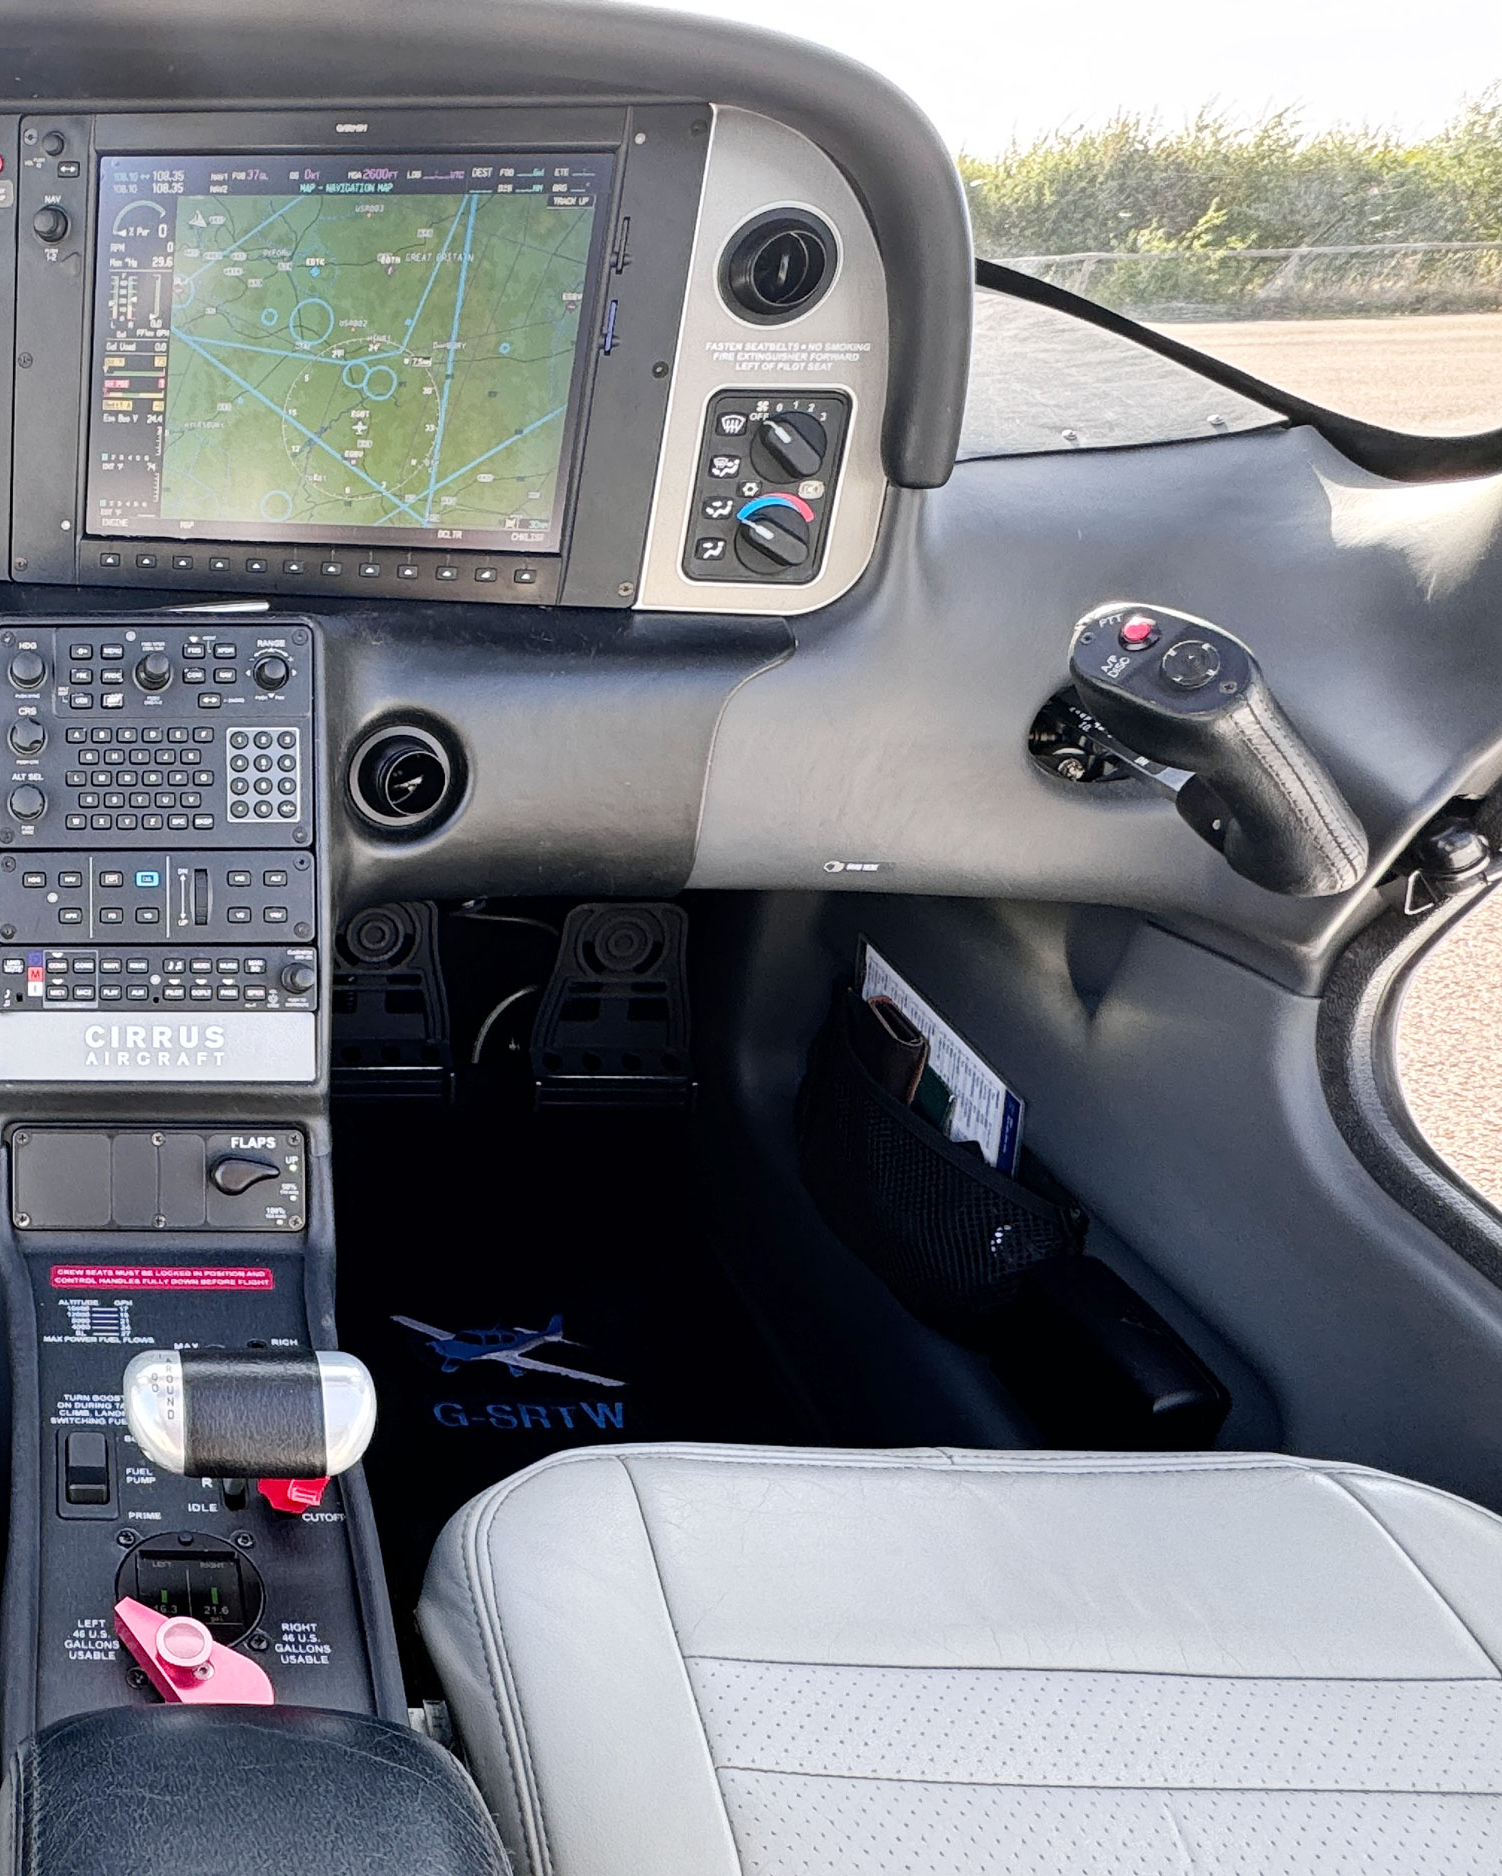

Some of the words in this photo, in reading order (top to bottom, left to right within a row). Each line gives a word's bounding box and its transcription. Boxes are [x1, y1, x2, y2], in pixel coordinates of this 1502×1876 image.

[325, 183, 375, 193] NAVIGATION
[45, 195, 62, 204] NAV
[705, 342, 743, 351] FASTEN
[744, 343, 799, 351] SEATBELTS
[808, 343, 823, 351] NO
[824, 343, 871, 351] SMOKING
[713, 352, 735, 361] FIRE
[737, 352, 808, 361] EXTINGUISHER
[809, 352, 860, 361] FORWARD
[735, 362, 759, 371] LEFT
[761, 362, 774, 371] OF
[776, 362, 805, 371] PILOT
[807, 362, 832, 371] SEAT
[749, 412, 770, 421] OFF
[776, 403, 783, 412] 0
[807, 403, 815, 412] 2
[820, 413, 827, 421] 3
[1099, 614, 1124, 629] PTT
[19, 642, 38, 650] HDG
[257, 640, 285, 648] RANGE
[18, 707, 37, 716] CRS
[12, 773, 26, 781] ALT
[28, 773, 43, 781] SEL
[85, 1025, 225, 1048] CIRRUS
[85, 1051, 225, 1066] AIRCRAFT
[231, 1137, 276, 1149] FLAPS
[285, 1156, 298, 1164] UP
[271, 1339, 298, 1347] RICH
[63, 1394, 90, 1402] TURN
[59, 1410, 93, 1418] CLIMB,
[433, 1402, 624, 1429] G-SRTW
[50, 1418, 106, 1426] SWITCHING
[126, 1468, 152, 1476] FUEL
[188, 1503, 217, 1513] IDLE
[128, 1512, 162, 1520] PRIME
[204, 1606, 229, 1615] 21.6
[78, 1619, 106, 1628] LEFT
[281, 1623, 317, 1632] RIGHT
[73, 1630, 85, 1638] 46
[89, 1630, 111, 1639] U.S.
[298, 1634, 321, 1642] U.S.
[64, 1639, 119, 1649] GALLONS
[275, 1643, 331, 1653] GALLONS
[69, 1650, 116, 1660] USABLE
[280, 1655, 329, 1664] USABLE
